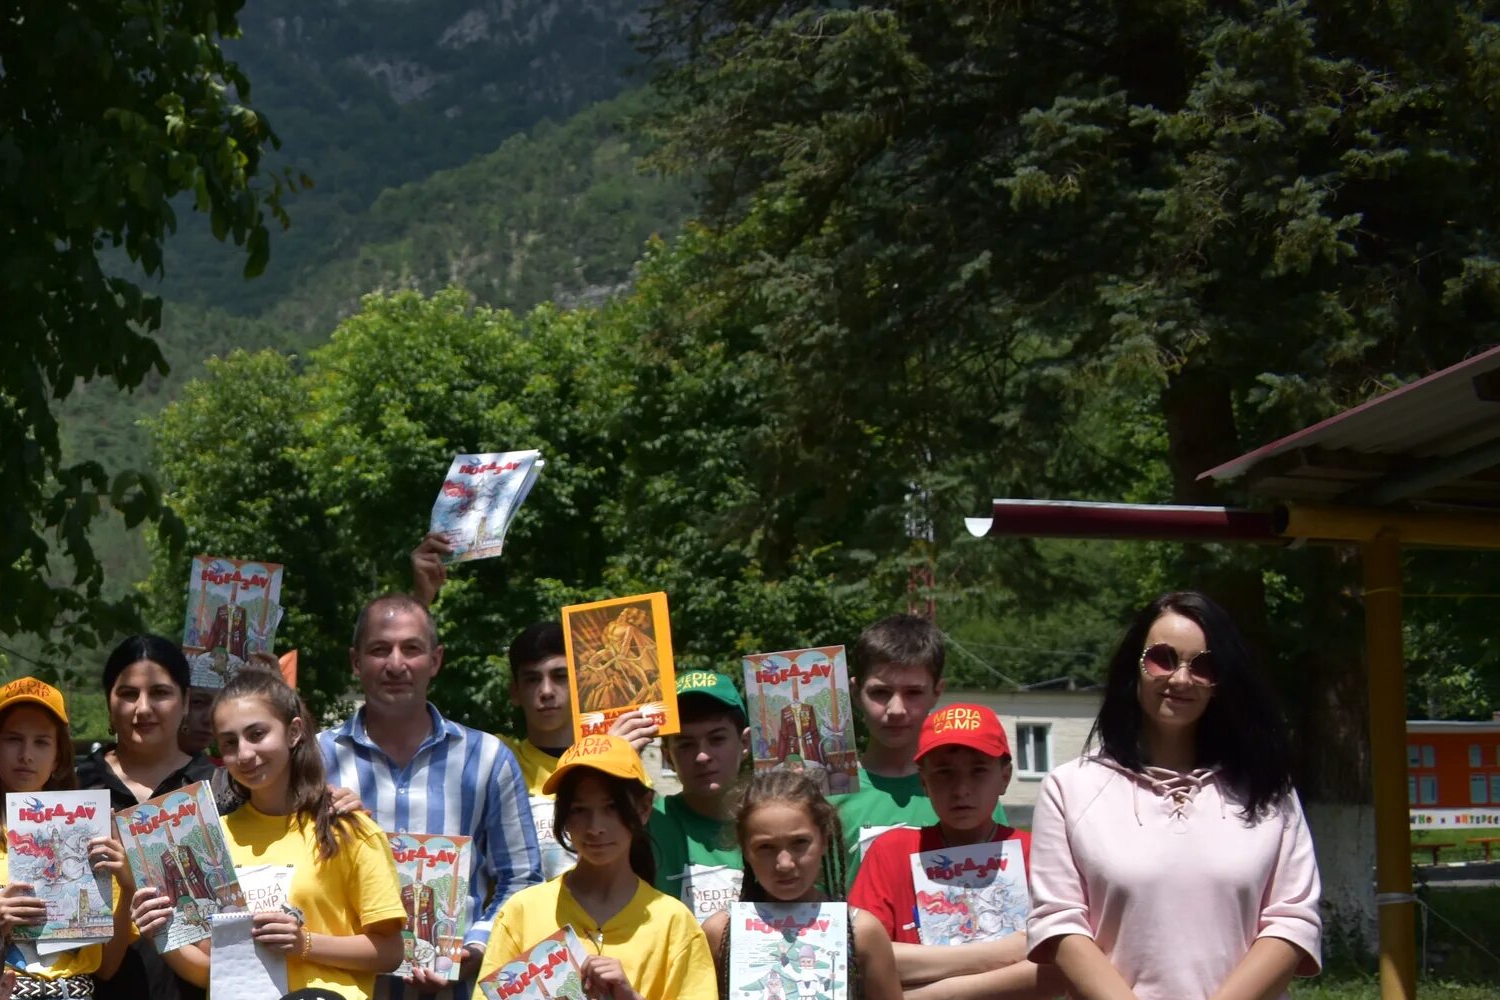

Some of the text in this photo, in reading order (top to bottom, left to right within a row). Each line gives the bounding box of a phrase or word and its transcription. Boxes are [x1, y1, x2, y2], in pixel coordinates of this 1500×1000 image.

[4, 679, 51, 693] MEDIA
[932, 708, 981, 724] MEDIA
[934, 720, 981, 734] CAMP
[248, 895, 279, 913] AMP
